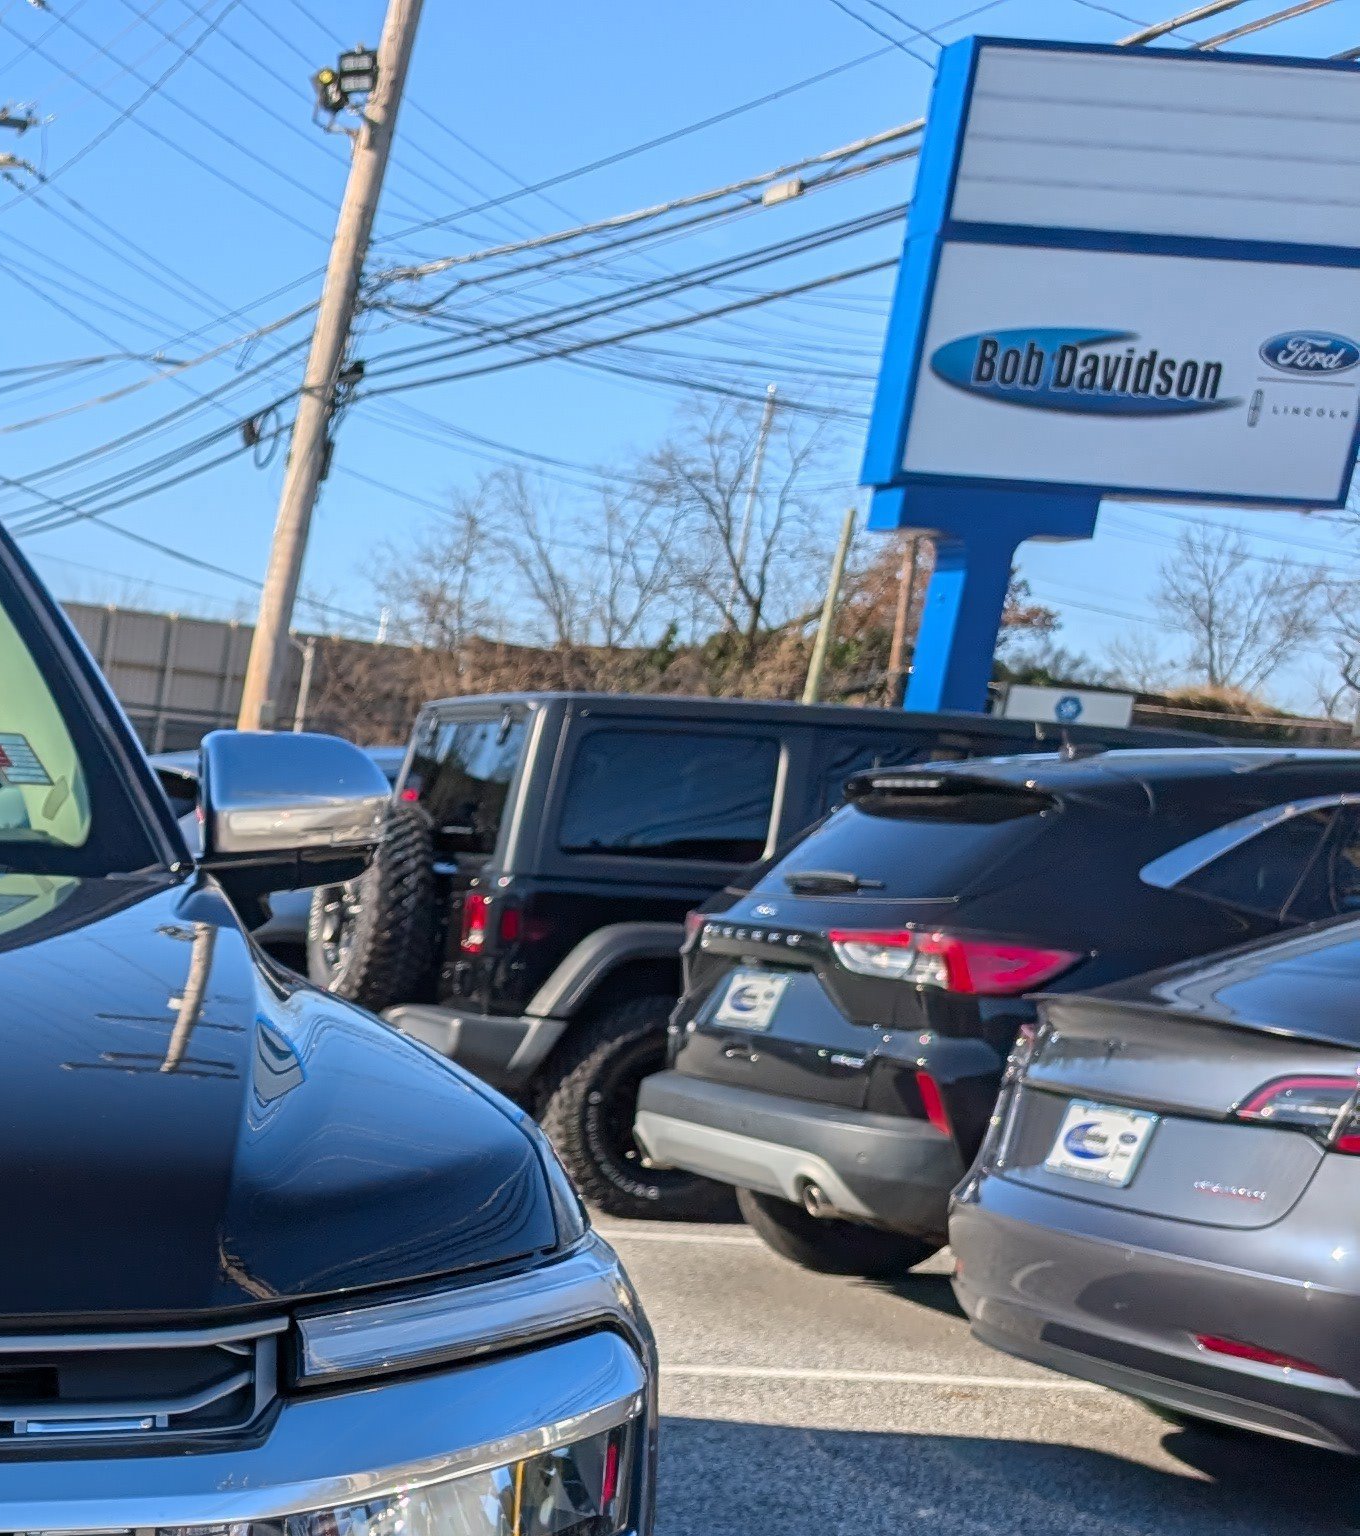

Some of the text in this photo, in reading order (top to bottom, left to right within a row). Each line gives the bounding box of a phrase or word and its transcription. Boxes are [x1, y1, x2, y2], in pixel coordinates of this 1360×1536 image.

[975, 338, 1222, 400] Bob Davidson
[1277, 337, 1346, 368] Ford
